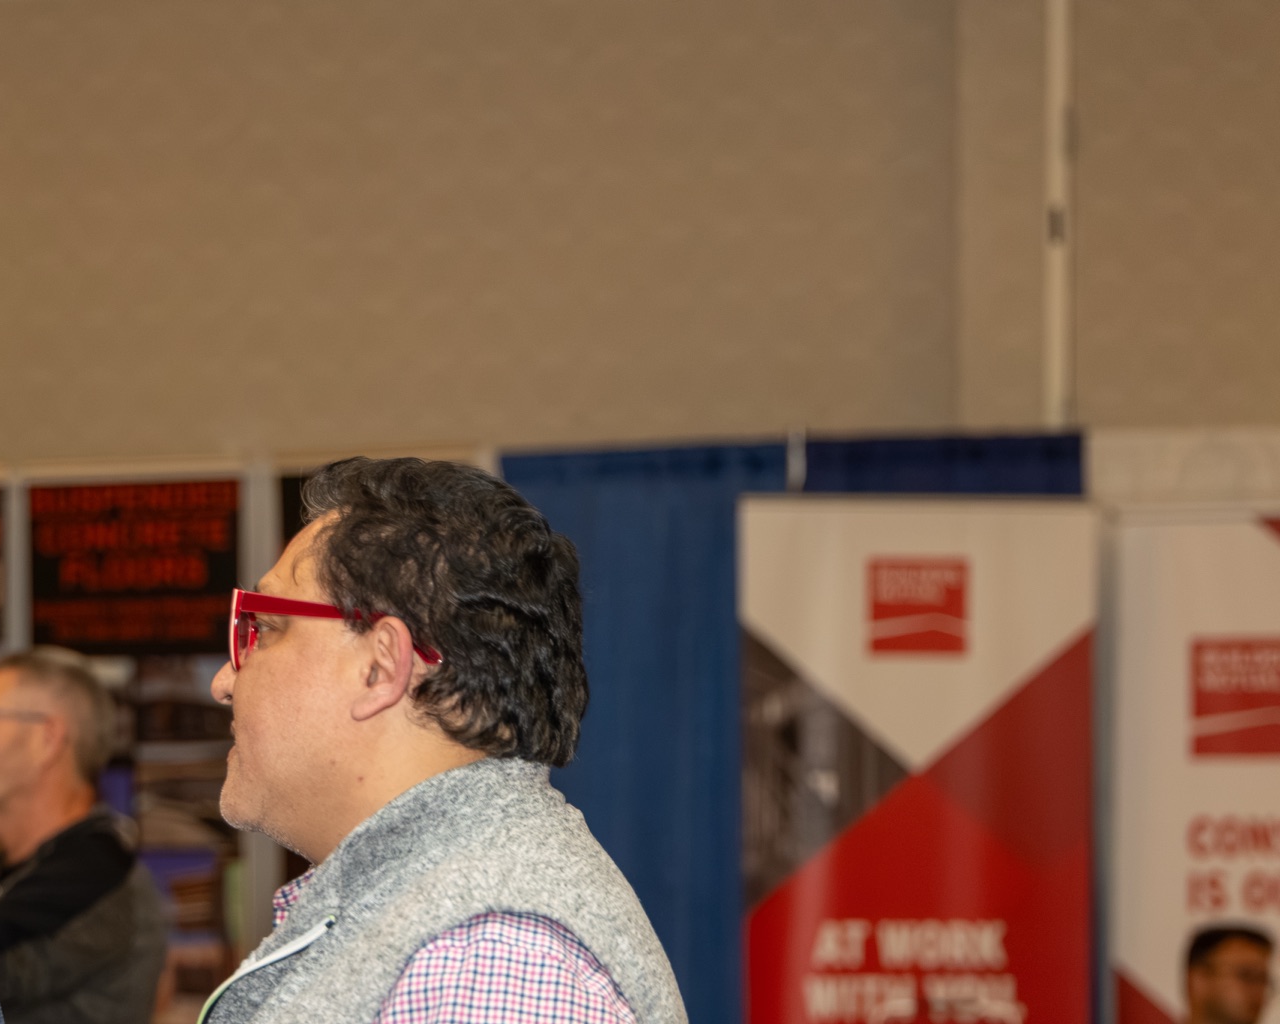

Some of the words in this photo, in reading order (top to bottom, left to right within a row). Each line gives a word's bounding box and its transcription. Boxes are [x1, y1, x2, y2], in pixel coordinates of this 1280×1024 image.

[813, 922, 869, 966] AT
[879, 922, 1007, 966] WORK
[804, 976, 916, 1021] WITH
